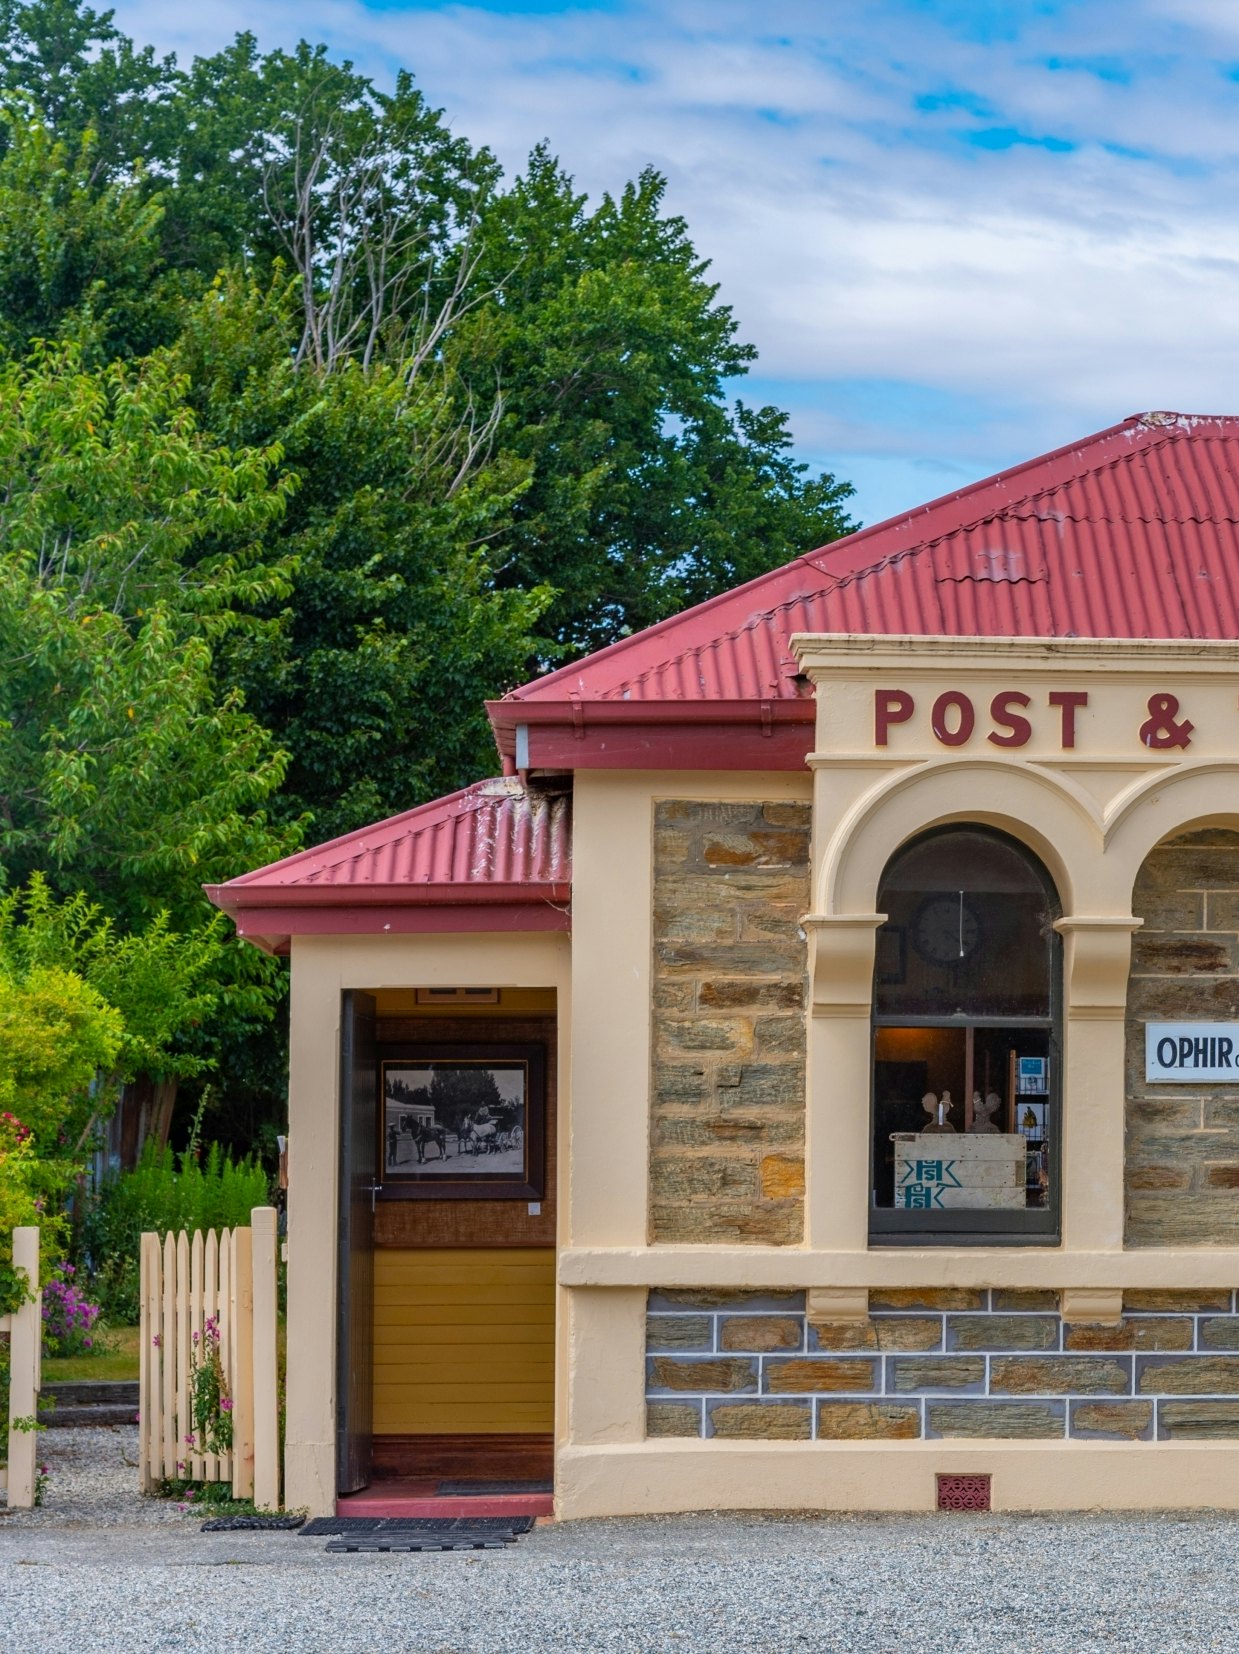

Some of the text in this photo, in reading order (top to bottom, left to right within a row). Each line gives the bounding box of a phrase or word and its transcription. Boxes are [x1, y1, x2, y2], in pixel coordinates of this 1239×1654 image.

[874, 690, 1088, 750] POST
[1139, 692, 1194, 750] &
[1156, 1036, 1234, 1069] OPHIR
